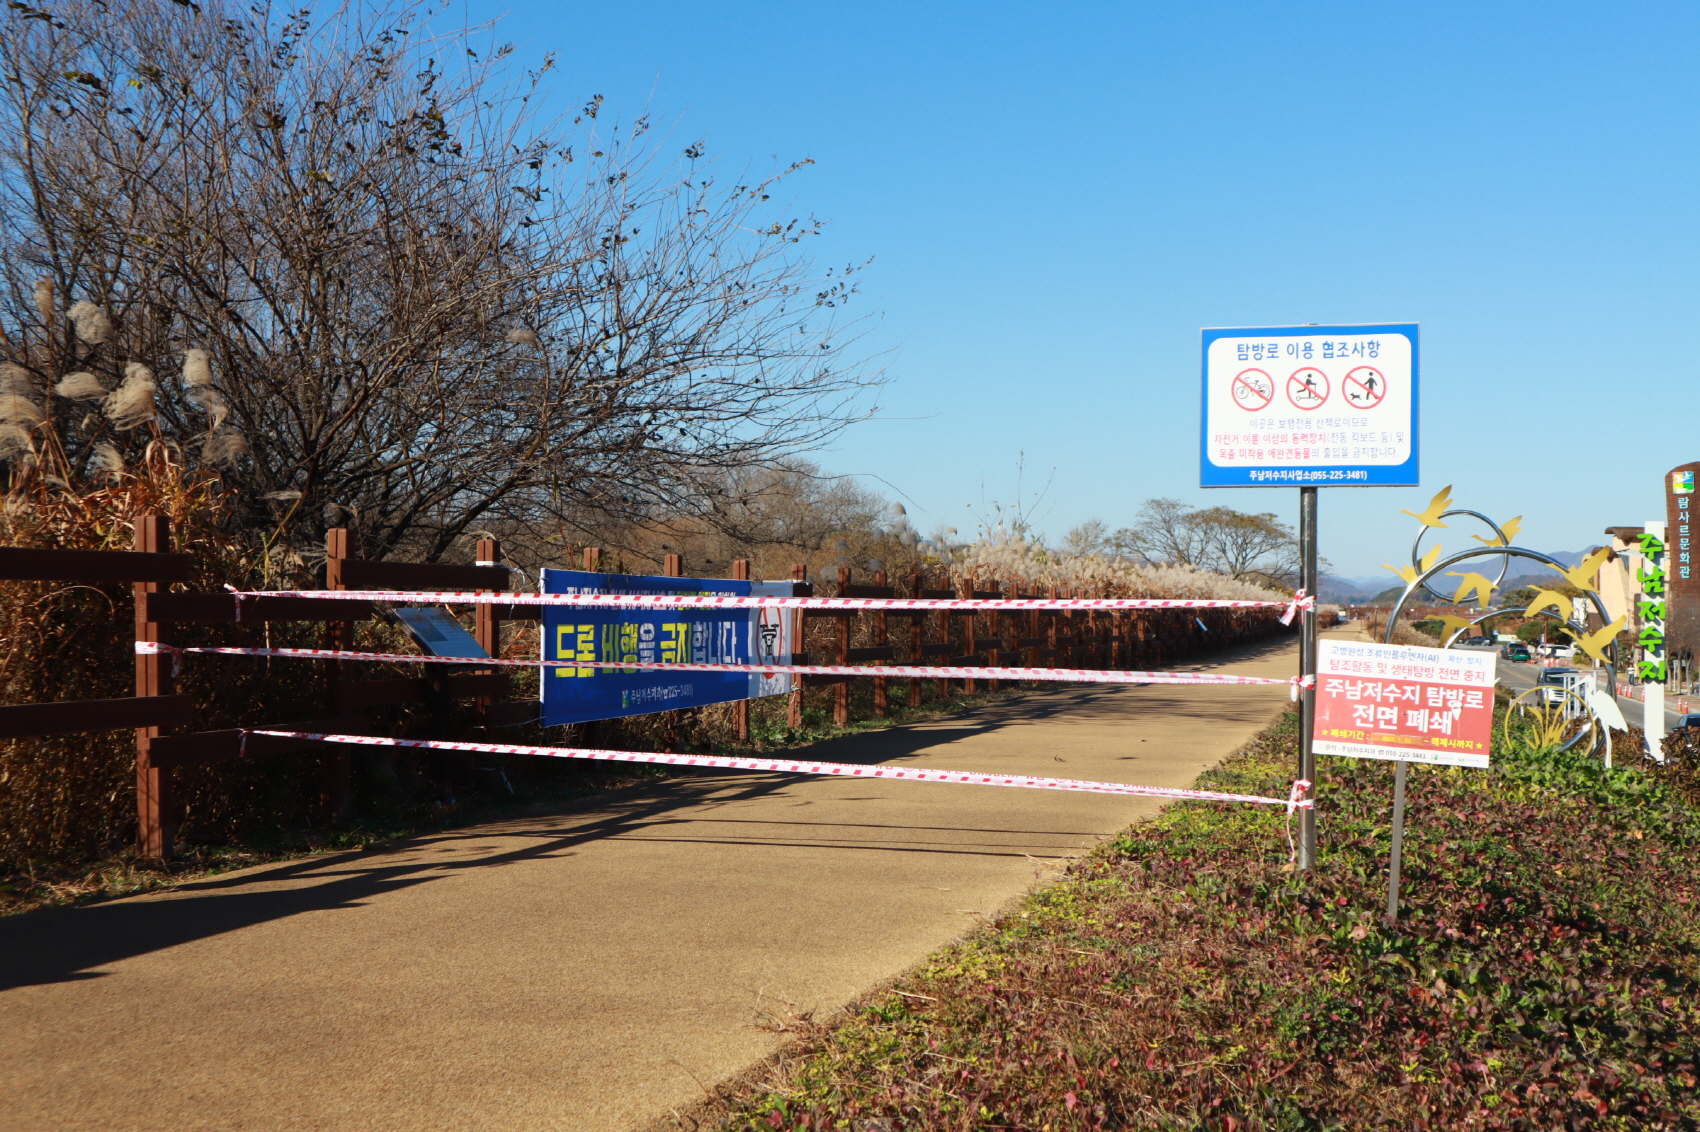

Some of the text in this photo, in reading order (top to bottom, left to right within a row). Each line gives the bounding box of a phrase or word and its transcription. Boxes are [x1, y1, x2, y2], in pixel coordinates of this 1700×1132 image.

[1237, 340, 1381, 361] 탐방로 이용 협조사항
[1249, 417, 1368, 430] 이곳은 보행전용 산책로이므로
[1213, 434, 1239, 446] 자전거
[1262, 433, 1288, 445] 이상의
[1291, 432, 1348, 445] 동력장치(전동
[1351, 432, 1377, 443] 킥보드
[1380, 432, 1393, 443] 등)
[1396, 431, 1405, 443] 및
[1219, 446, 1399, 460] 목줄 미착용 애완견동물의 출입을 금지합니다.
[1249, 470, 1368, 481] 주남저수지사업소(055-225-3481)
[1678, 497, 1691, 579] 람사르문화관
[1637, 533, 1666, 681] 주남저수지
[555, 621, 742, 678] 드론 비행을 금지합니다.
[1331, 646, 1364, 657] 고병원성
[1366, 648, 1440, 663] 조류인플루엔자(AI)
[1329, 659, 1485, 683] 탐조활동 및 생태탐방 전면 중지
[1325, 678, 1485, 709] 주남저수지 탐방로
[1352, 704, 1454, 735] 전면 폐쇄
[1431, 737, 1474, 750] 해제시까지
[1385, 749, 1427, 760] 055-225-3481
